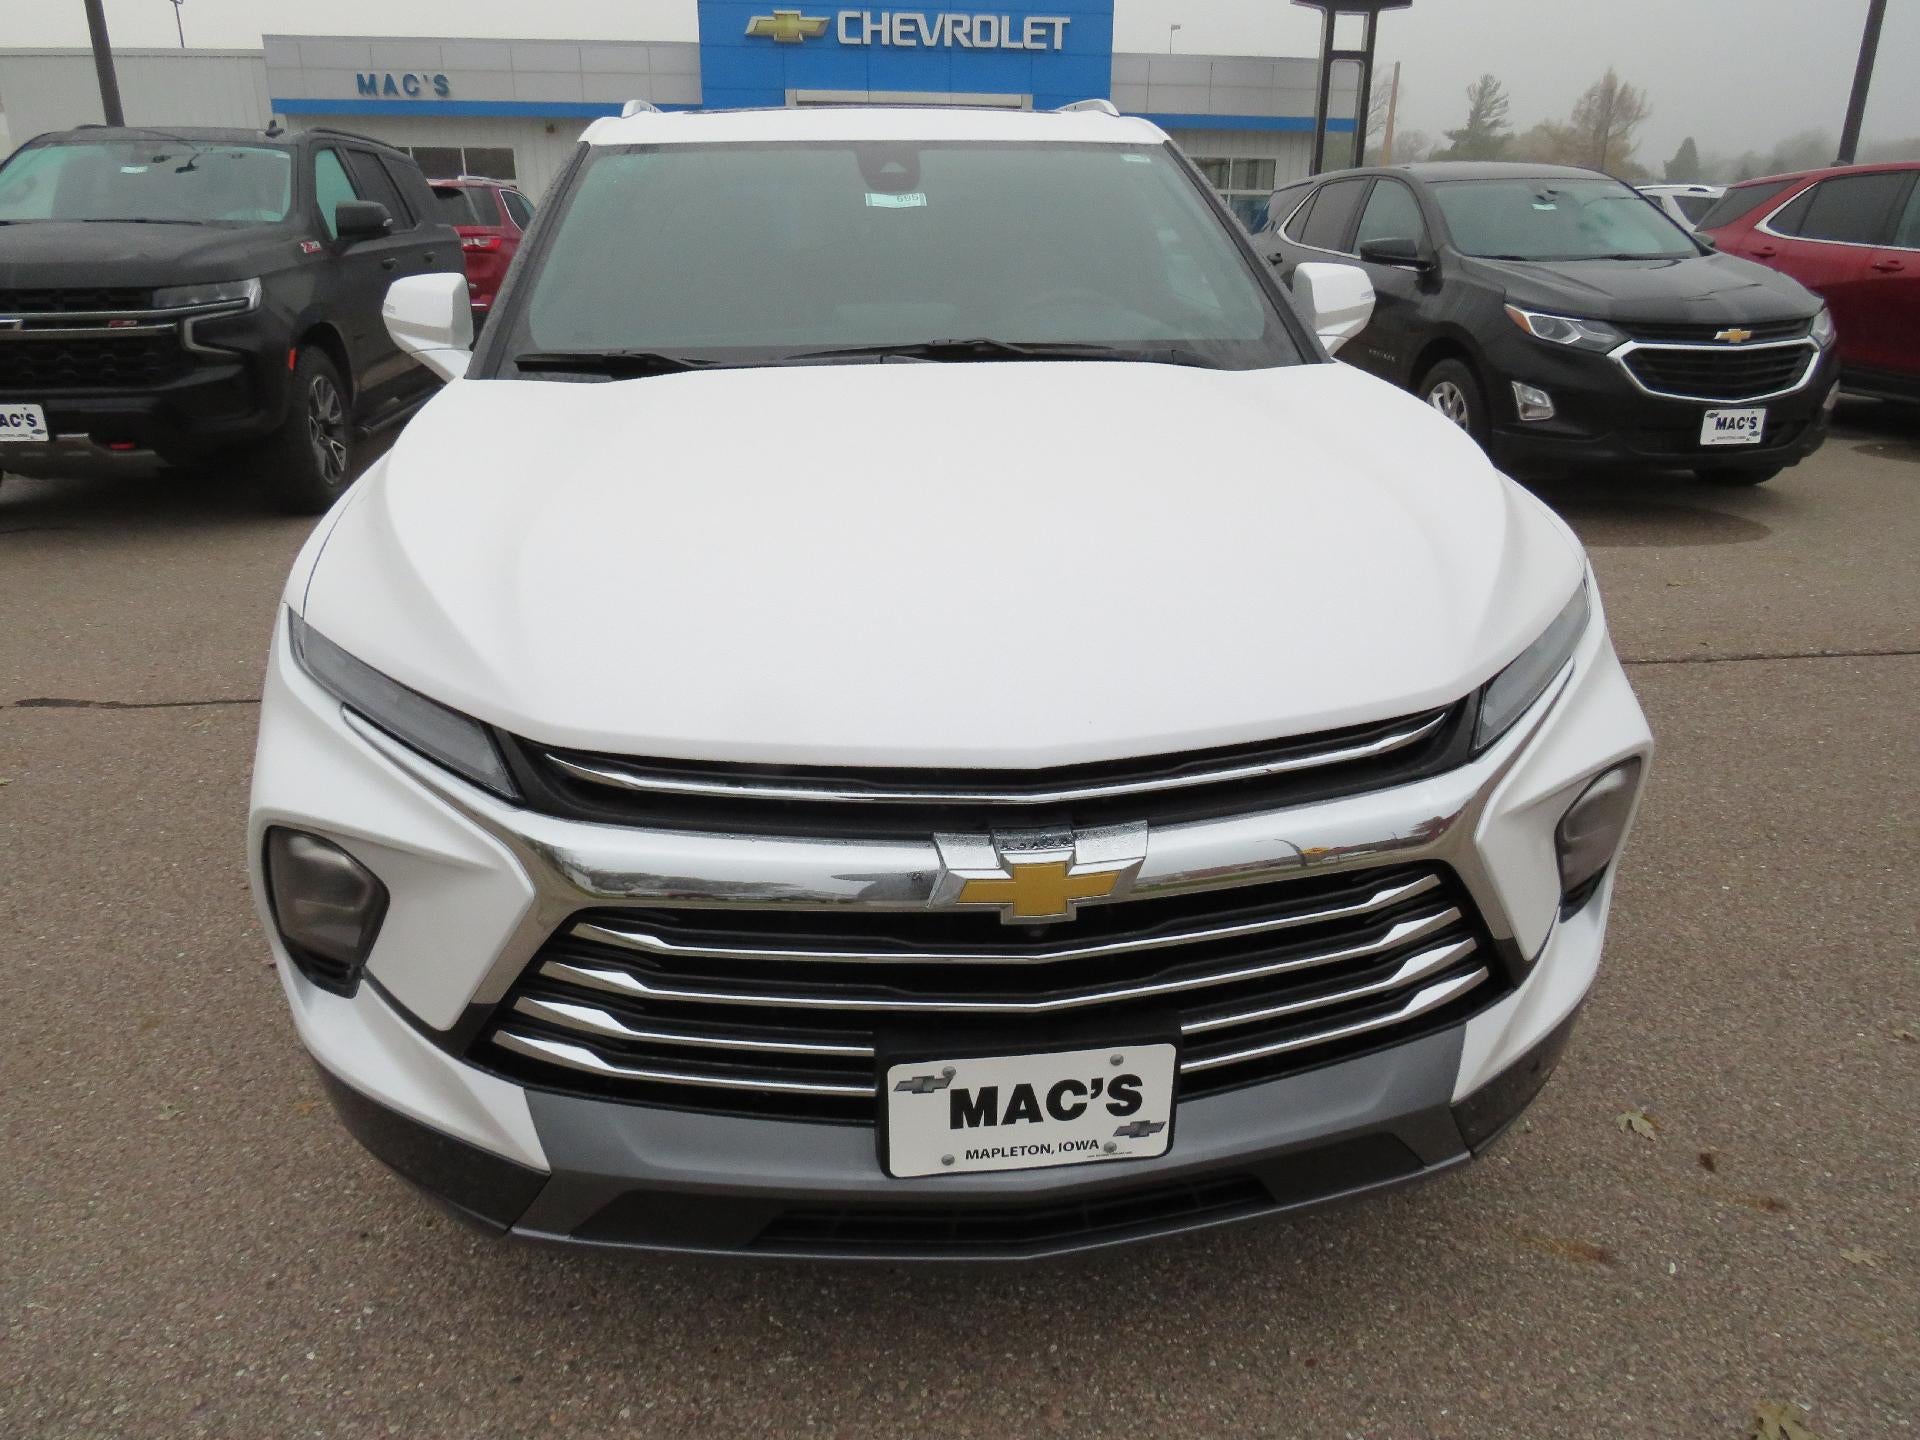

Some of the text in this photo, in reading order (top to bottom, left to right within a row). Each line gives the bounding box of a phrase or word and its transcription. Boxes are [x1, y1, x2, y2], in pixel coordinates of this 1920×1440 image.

[837, 10, 1071, 50] CHEVROLET
[356, 72, 450, 97] MAC'S
[0, 413, 37, 428] AC'S
[1715, 416, 1758, 431] MAC'S
[949, 1073, 1143, 1130] MAC'S
[965, 1139, 1100, 1160] MAPLETON, IOWA
